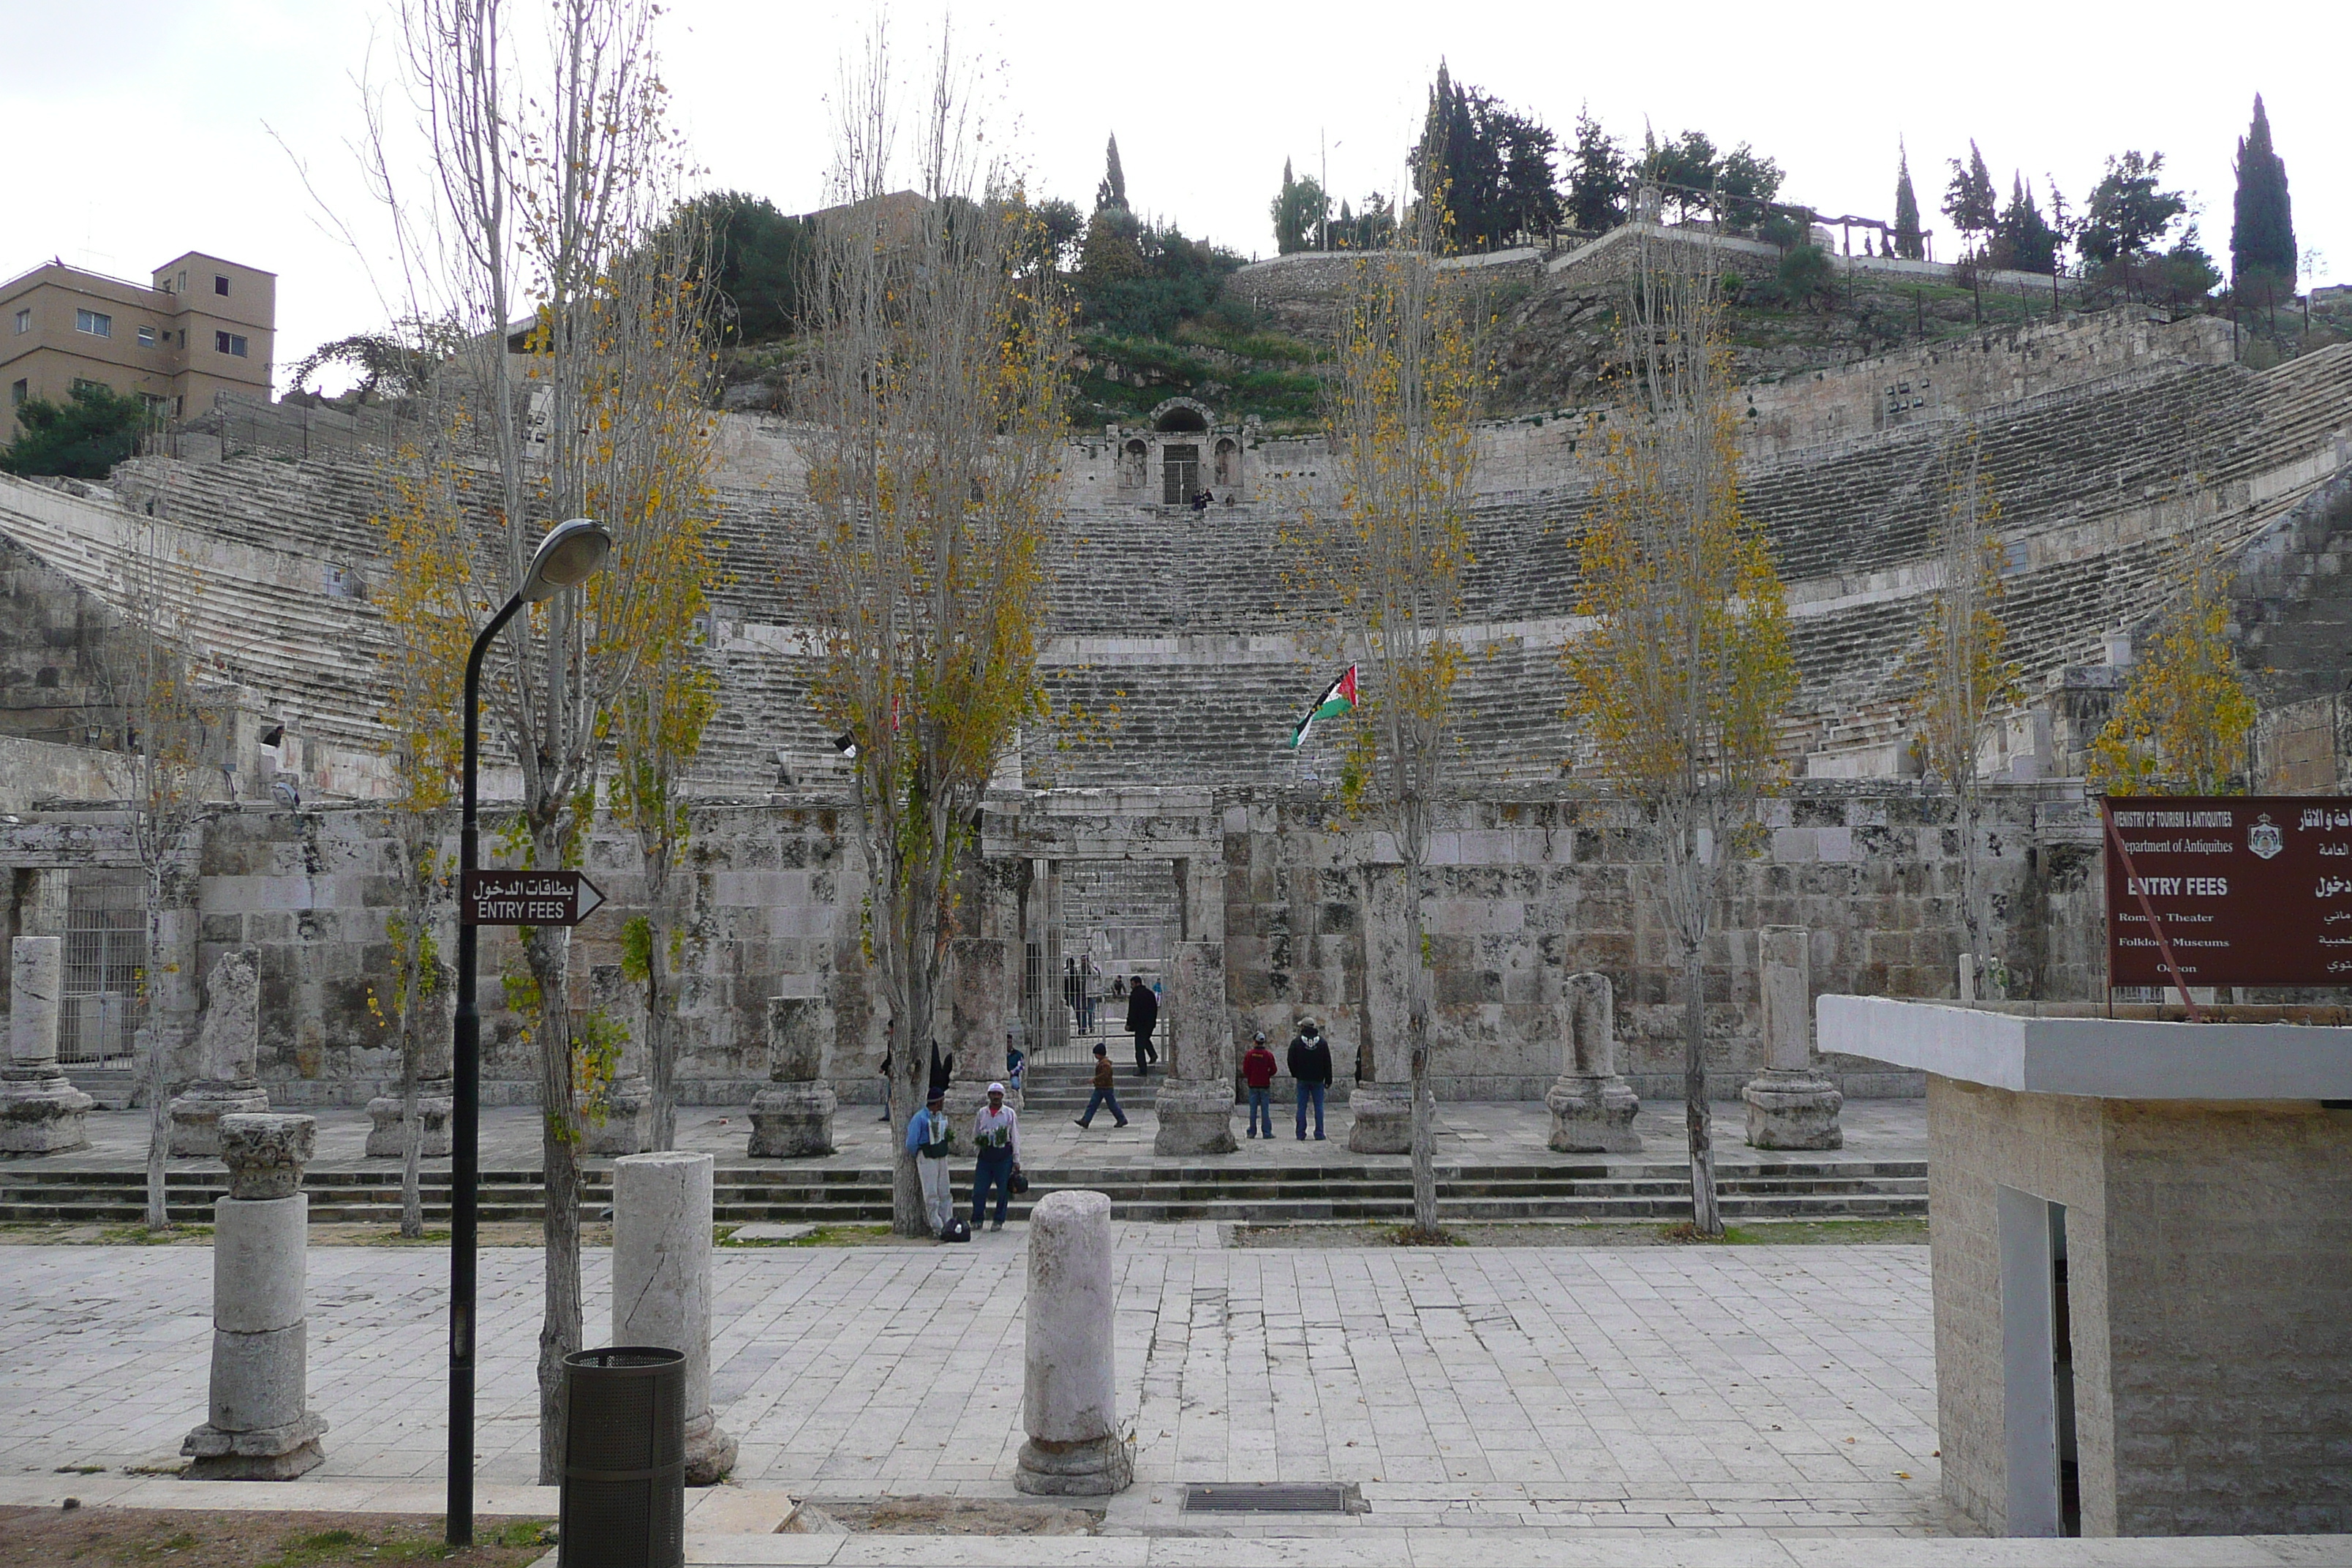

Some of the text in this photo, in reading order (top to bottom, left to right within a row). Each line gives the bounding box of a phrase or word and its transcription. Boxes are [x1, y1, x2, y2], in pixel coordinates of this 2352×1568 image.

[2146, 811, 2155, 827] OF
[2157, 811, 2185, 827] TOURISM
[2186, 811, 2191, 827] &
[2192, 811, 2233, 828] ANTIQUITIES
[2120, 838, 2234, 855] epartment of Antiquities
[2318, 842, 2349, 856] العامة
[472, 879, 574, 901] بطاقات الدخول
[2127, 877, 2228, 896] ENTRY FEES
[478, 901, 565, 919] ENTRY FEES
[2119, 913, 2215, 922] Romn Theater
[2324, 911, 2352, 925] ماني
[2119, 937, 2230, 947] Folklo Museums
[2157, 963, 2197, 973] Oeon
